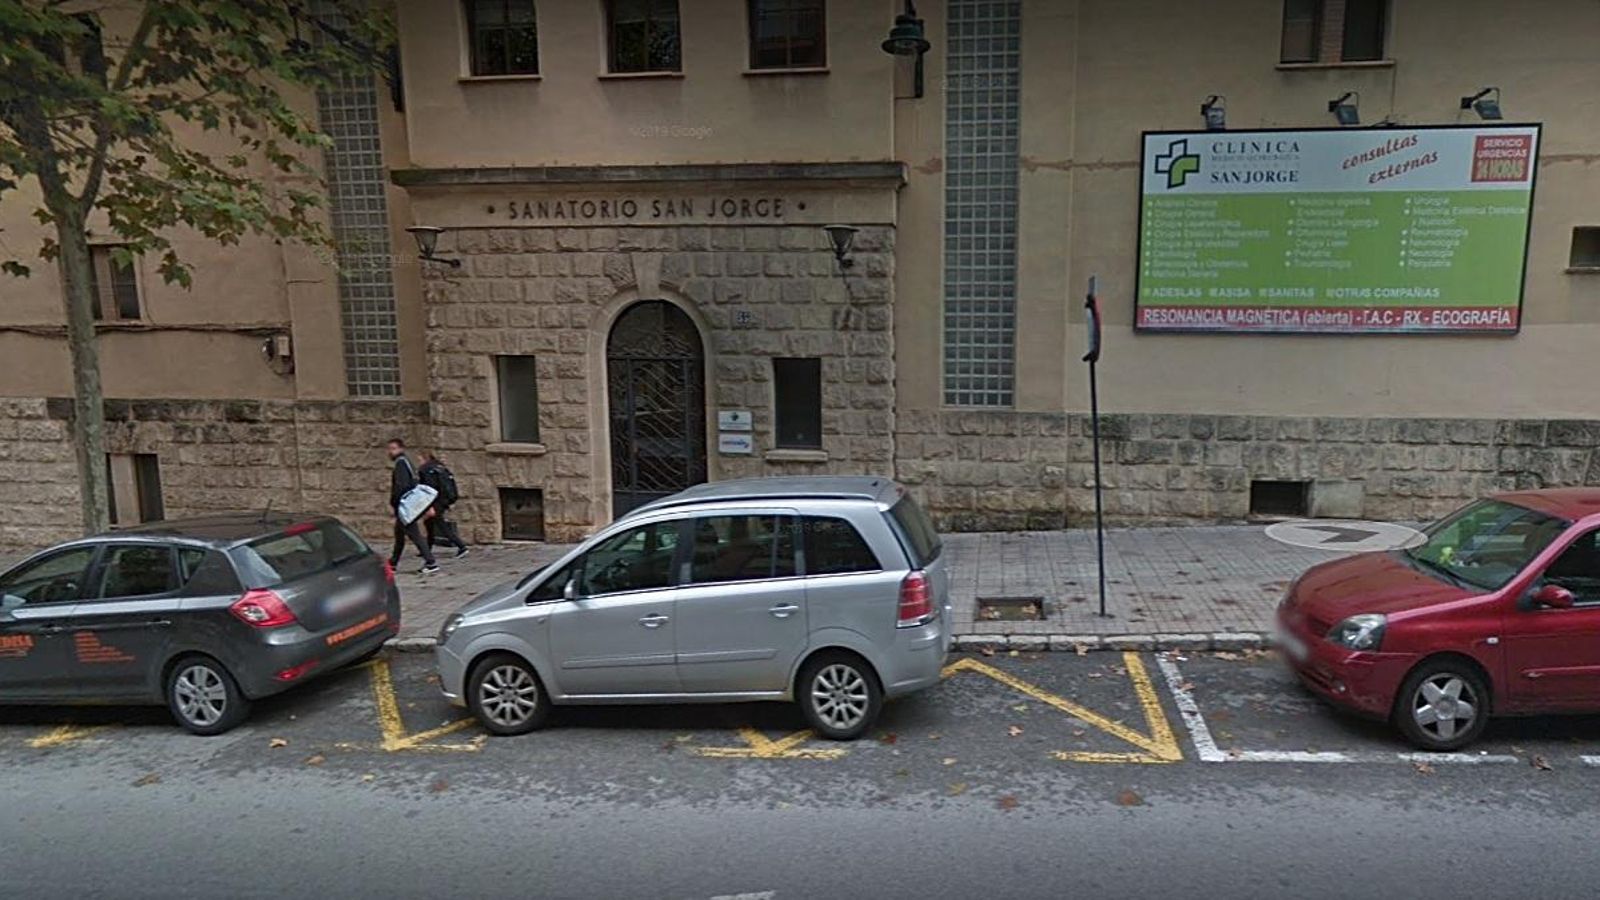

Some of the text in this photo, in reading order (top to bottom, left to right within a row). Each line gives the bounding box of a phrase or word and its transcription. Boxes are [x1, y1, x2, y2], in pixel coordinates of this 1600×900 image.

[1211, 140, 1300, 154] CLINICA
[1483, 138, 1523, 148] SERVICIO
[1342, 134, 1418, 170] consultas
[1476, 148, 1528, 158] URGENCIAS
[1367, 151, 1439, 184] externas
[1489, 158, 1523, 179] HORAS
[508, 198, 783, 219] SANATORIO SAN JORGE
[1152, 287, 1201, 298] ADESLAS
[1267, 287, 1315, 298] SANITAS
[1335, 287, 1371, 298] OTRAS
[1143, 308, 1224, 323] RESONANCIA
[1225, 306, 1300, 324] MAGNÉTICA
[1302, 309, 1352, 326] (abierta)
[1403, 310, 1421, 324] RX
[1432, 307, 1511, 325] ECOGRAFÍA
